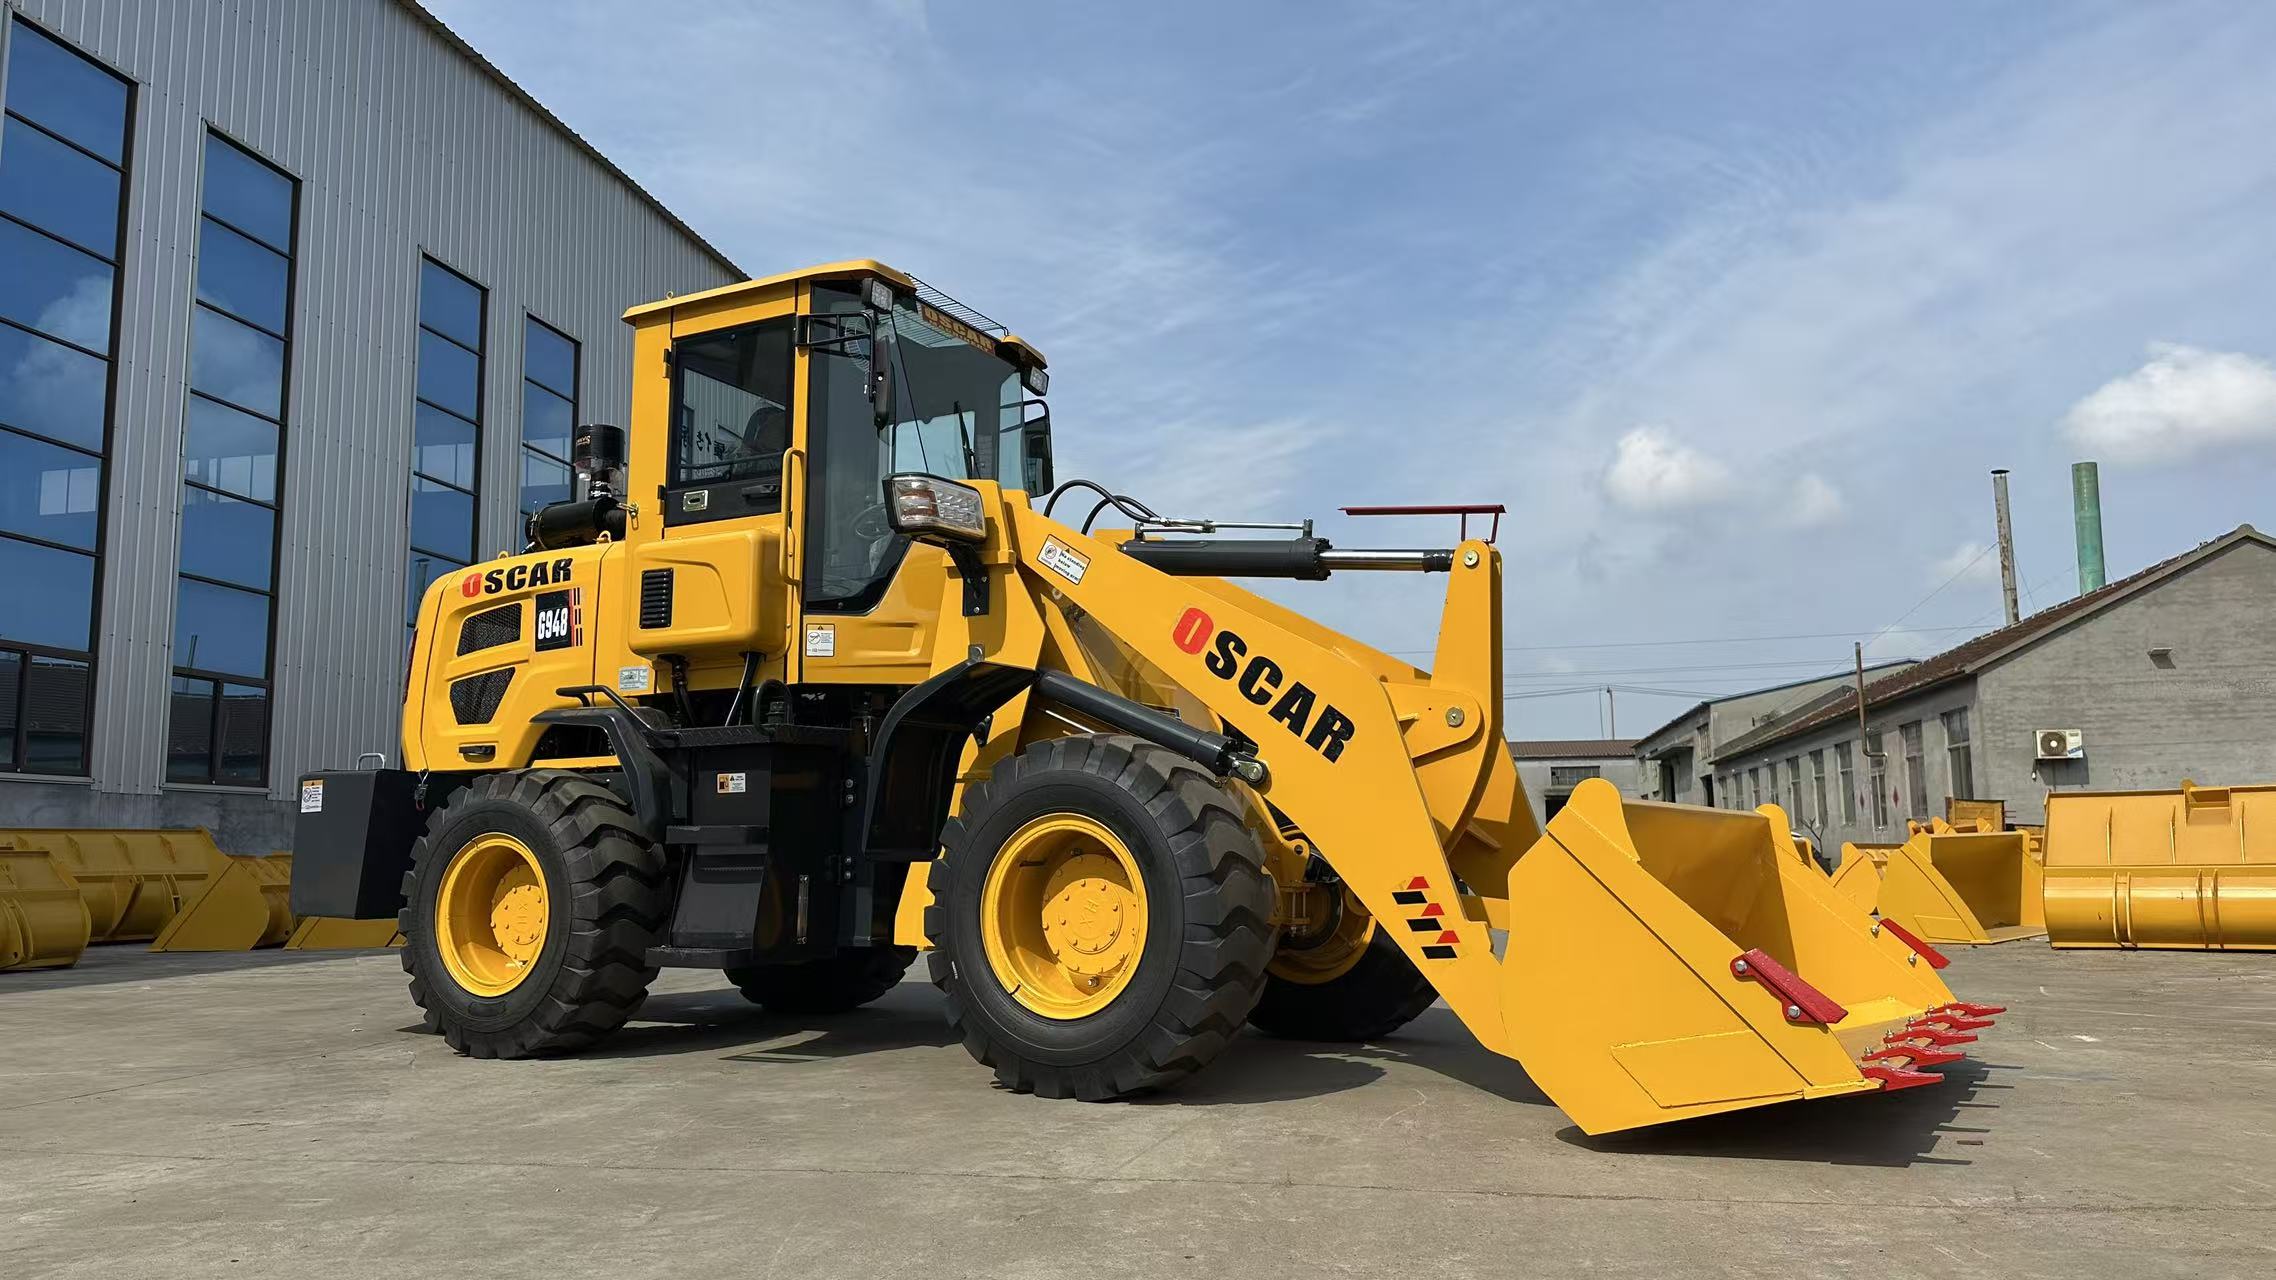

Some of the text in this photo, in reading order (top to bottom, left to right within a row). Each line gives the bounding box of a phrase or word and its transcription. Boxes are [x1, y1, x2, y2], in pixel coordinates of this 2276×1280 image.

[924, 306, 994, 352] OSCAR
[462, 557, 573, 598] OSCAR
[1054, 564, 1070, 576] moving
[1058, 559, 1070, 568] below
[1066, 557, 1085, 570] standing
[538, 607, 568, 639] G948
[1173, 608, 1355, 763] OSCAR
